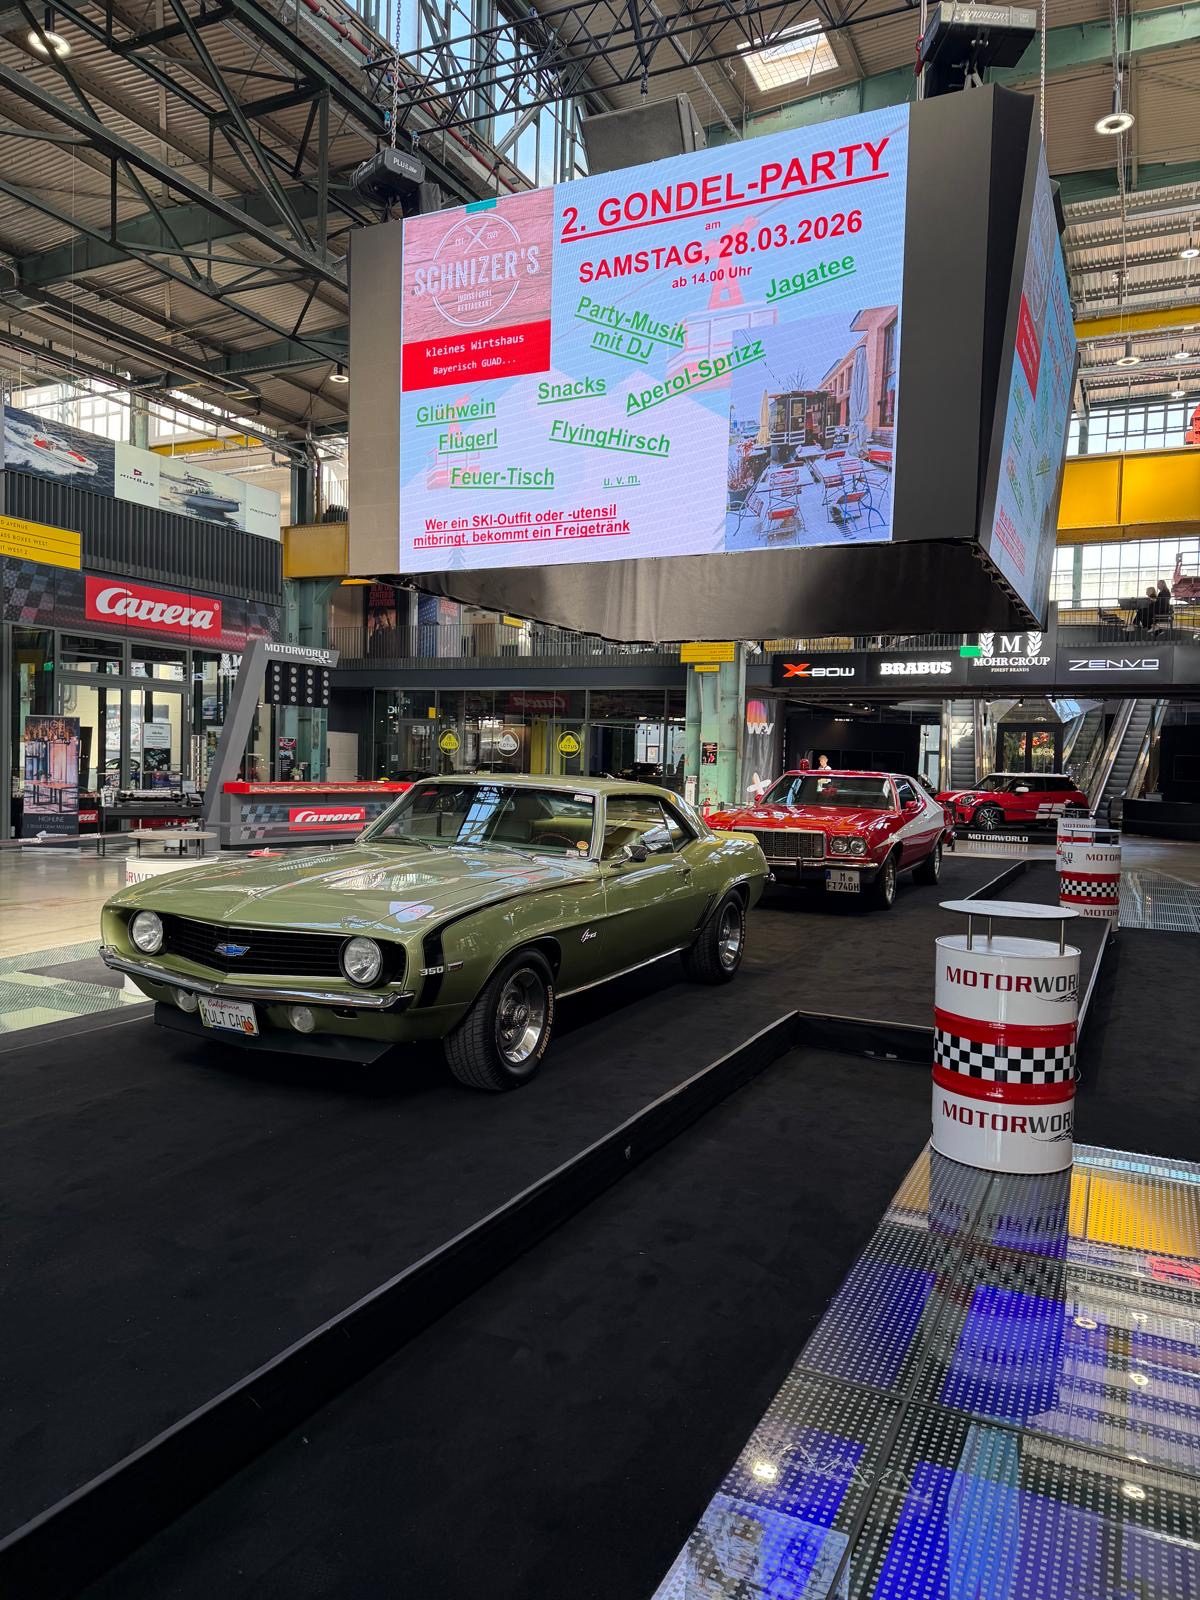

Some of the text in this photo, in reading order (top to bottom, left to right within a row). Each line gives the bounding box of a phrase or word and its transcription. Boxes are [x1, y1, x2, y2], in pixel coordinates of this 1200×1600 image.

[561, 137, 890, 236] 2. GONDEL-PARTY
[704, 220, 721, 231] am
[578, 209, 863, 284] SAMSTAG, 28.03.2026
[414, 245, 541, 297] SCHNIZER'S
[671, 264, 753, 289] ab 14.00 Uhr
[766, 254, 856, 302] Jagatee
[576, 295, 688, 346] Party-Musik
[425, 334, 525, 358] kleines Wirtshaus
[592, 330, 655, 362] mit DJ
[433, 356, 517, 376] Bayerisch GUAD...
[626, 338, 766, 415] Aperol-Sprizz
[537, 378, 607, 402] Snacks
[416, 398, 496, 426] Glühwein
[438, 427, 498, 453] Flügerl
[549, 419, 671, 456] FlyingHirsch
[450, 466, 555, 488] Feuer-Tisch
[425, 503, 618, 532] Wer ein SKI-Outfit oder -utensil
[413, 519, 631, 548] mitbringt, bekommt ein Freigetränk
[95, 586, 215, 630] Carrera
[264, 642, 330, 659] MOTORWORLD
[1000, 635, 1023, 653] M
[783, 664, 855, 678] X-BOW
[879, 661, 952, 676] BRABUS
[973, 656, 1051, 668] MOHR GROUP
[1068, 659, 1160, 671] ZENVO
[441, 741, 457, 749] LOTUS
[967, 833, 1029, 843] MOTORWORLD
[840, 872, 846, 882] M
[419, 965, 444, 976] 350
[207, 999, 240, 1011] California
[203, 1007, 255, 1032] KULT CARS
